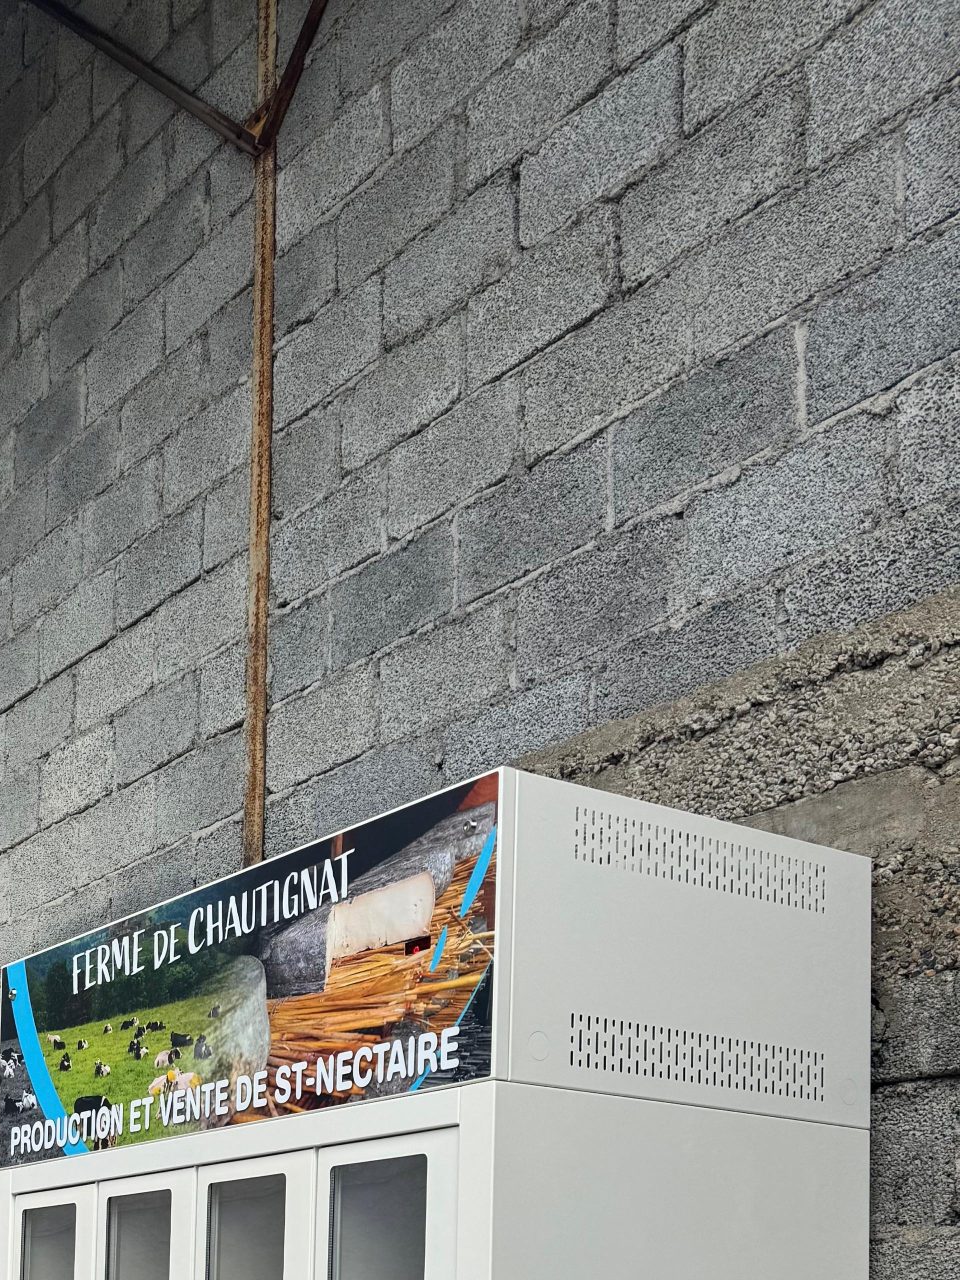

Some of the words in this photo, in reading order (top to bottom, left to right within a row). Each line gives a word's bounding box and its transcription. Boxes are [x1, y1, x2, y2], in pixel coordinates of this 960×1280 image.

[71, 928, 145, 996] FERME
[153, 922, 181, 969] DE
[187, 848, 356, 954] CHAUTIGNAT
[10, 1103, 124, 1156] PRODUCTION
[129, 1097, 155, 1133] ET
[159, 1078, 229, 1127] VENTE
[236, 1073, 268, 1109] DE
[274, 1027, 461, 1103] ST-NECTAIRE
